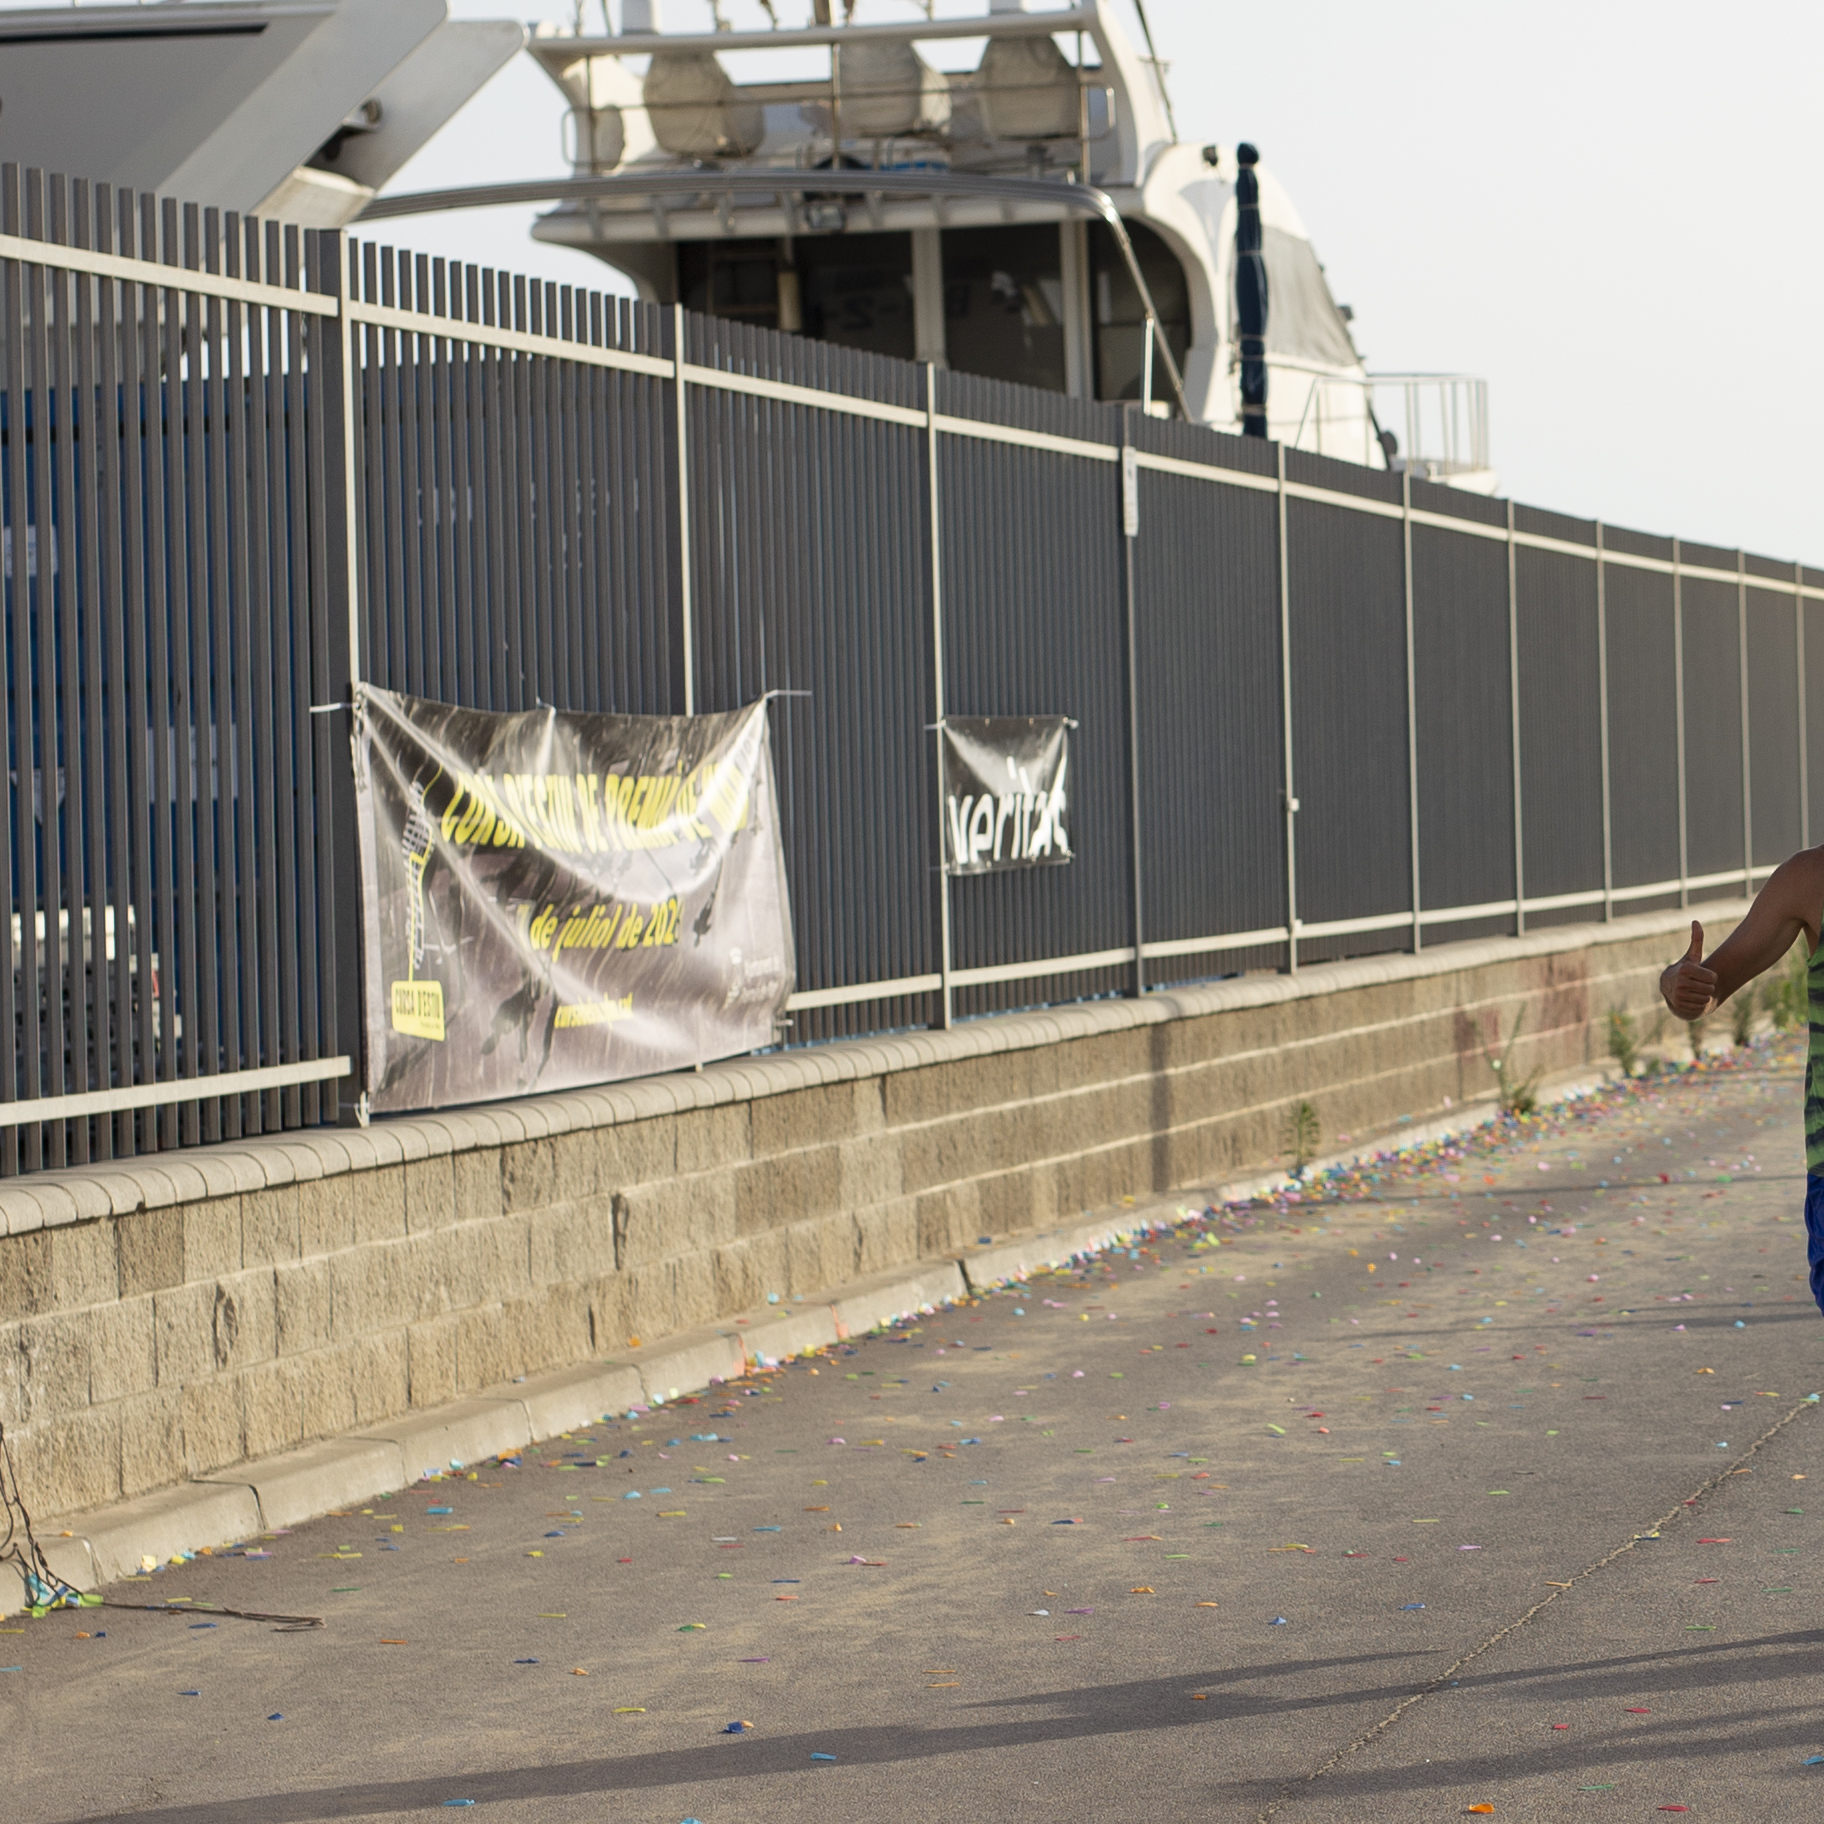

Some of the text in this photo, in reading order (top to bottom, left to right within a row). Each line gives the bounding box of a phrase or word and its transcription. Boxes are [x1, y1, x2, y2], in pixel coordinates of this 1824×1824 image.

[530, 904, 558, 950] de
[552, 904, 623, 963] juliol
[615, 902, 644, 950] de
